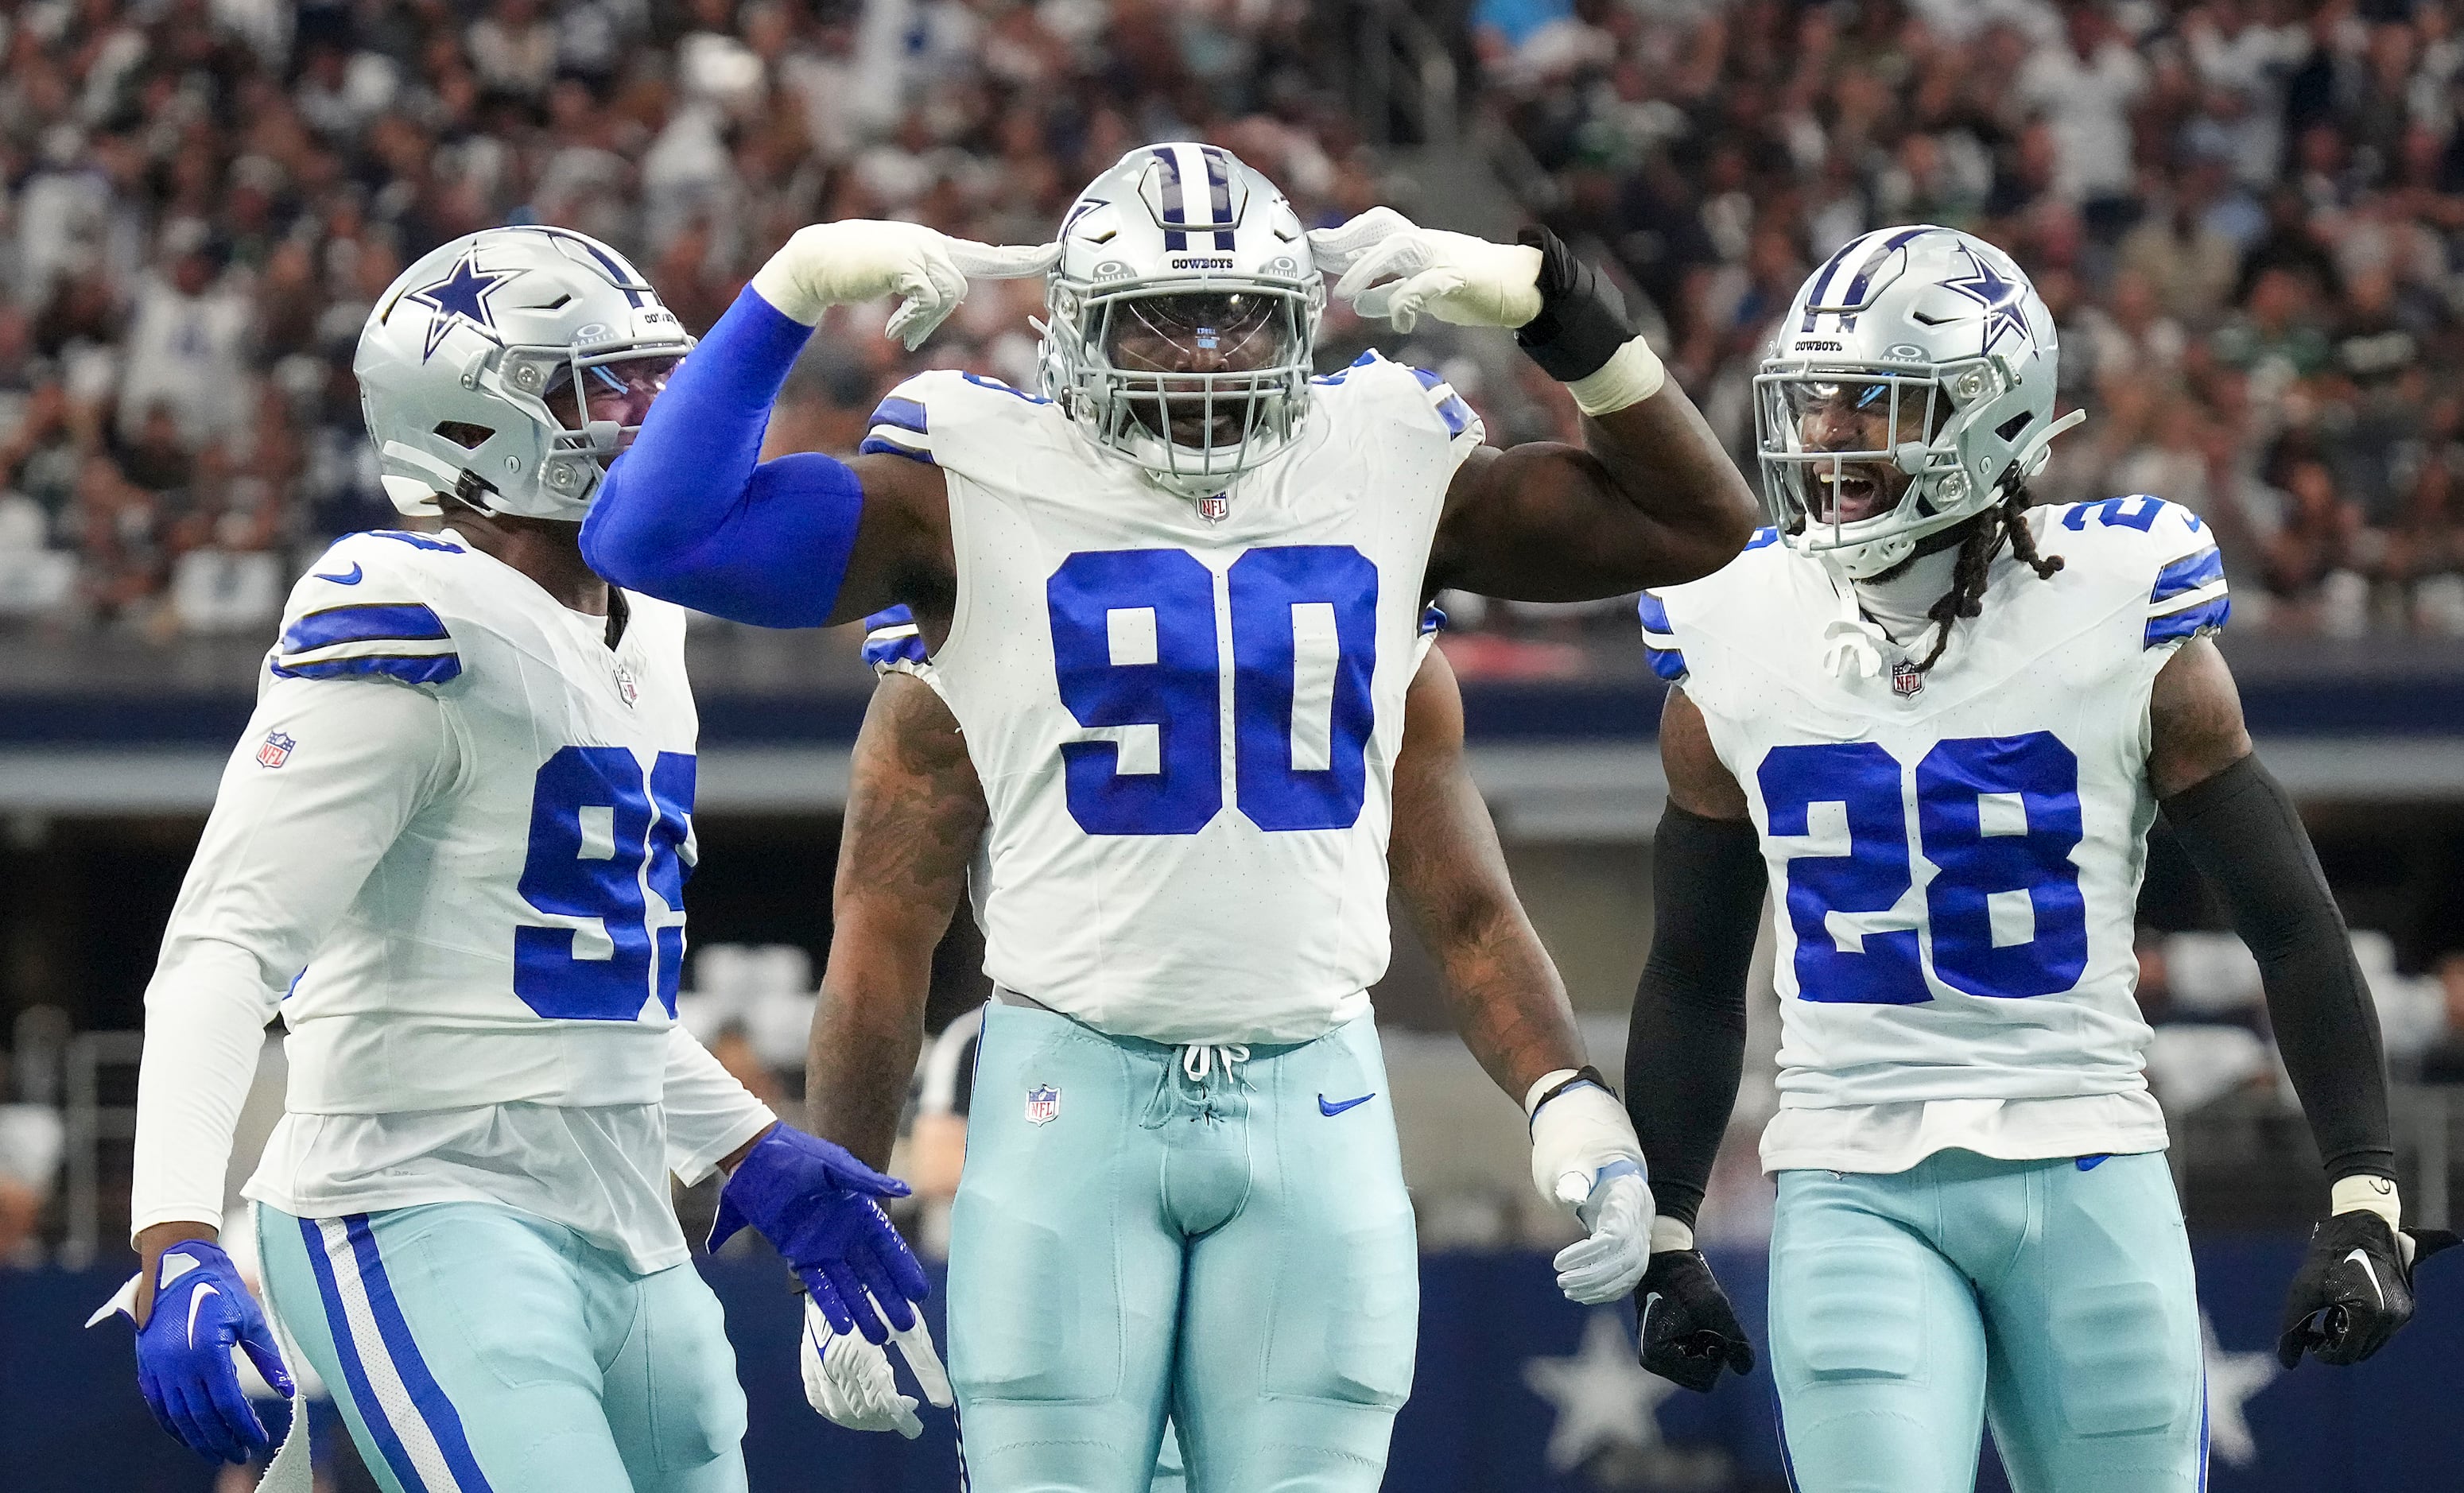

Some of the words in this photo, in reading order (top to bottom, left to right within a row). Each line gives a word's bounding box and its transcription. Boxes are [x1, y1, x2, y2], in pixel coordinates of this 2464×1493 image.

[1172, 258, 1233, 269] COWBOYS
[1795, 340, 1843, 351] COWBOYS
[1201, 499, 1225, 517] NFL
[1047, 545, 1379, 835] 90
[1896, 674, 1919, 692] NFL
[258, 743, 285, 765] NFL
[1756, 730, 2089, 1005] 28
[1031, 1102, 1054, 1119] NFL
